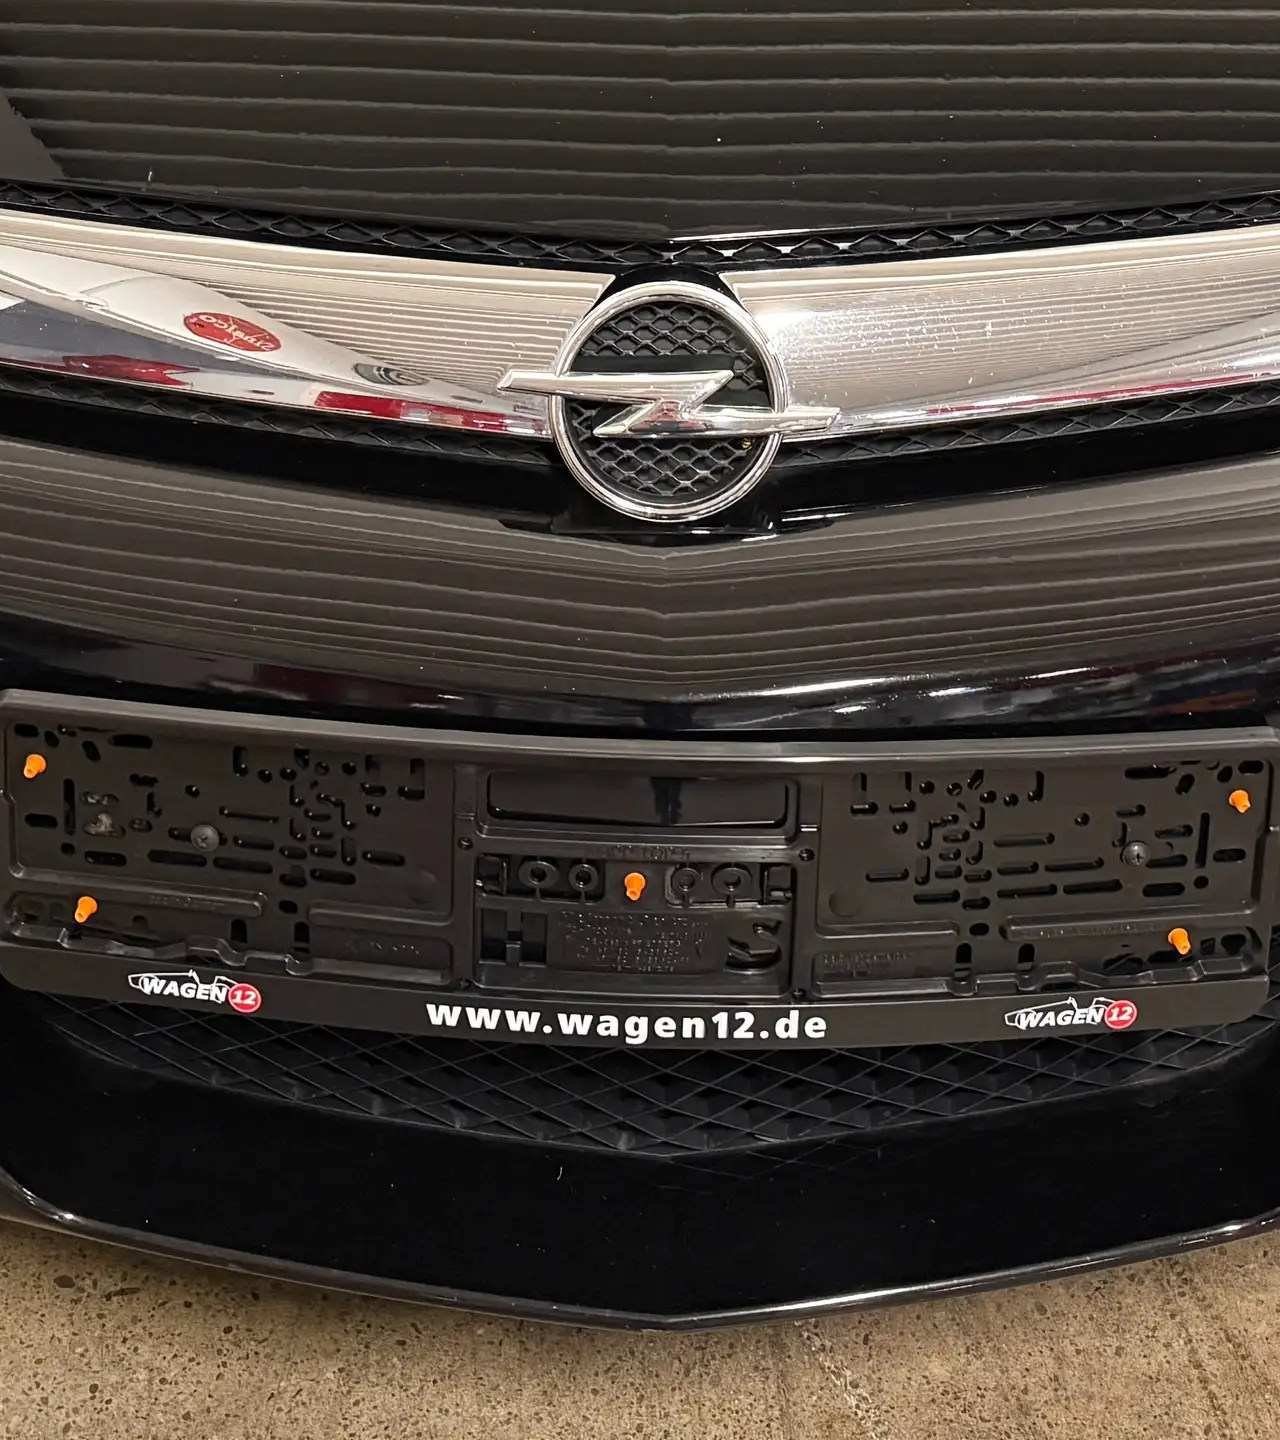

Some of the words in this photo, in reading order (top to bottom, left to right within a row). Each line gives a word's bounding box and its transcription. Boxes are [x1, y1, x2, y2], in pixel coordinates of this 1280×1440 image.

[142, 977, 227, 1003] WAGEN
[232, 989, 256, 1005] 12
[426, 1003, 827, 1044] www.wagen12.de
[1019, 1007, 1104, 1029] WAGEN
[1107, 1006, 1133, 1022] 12
